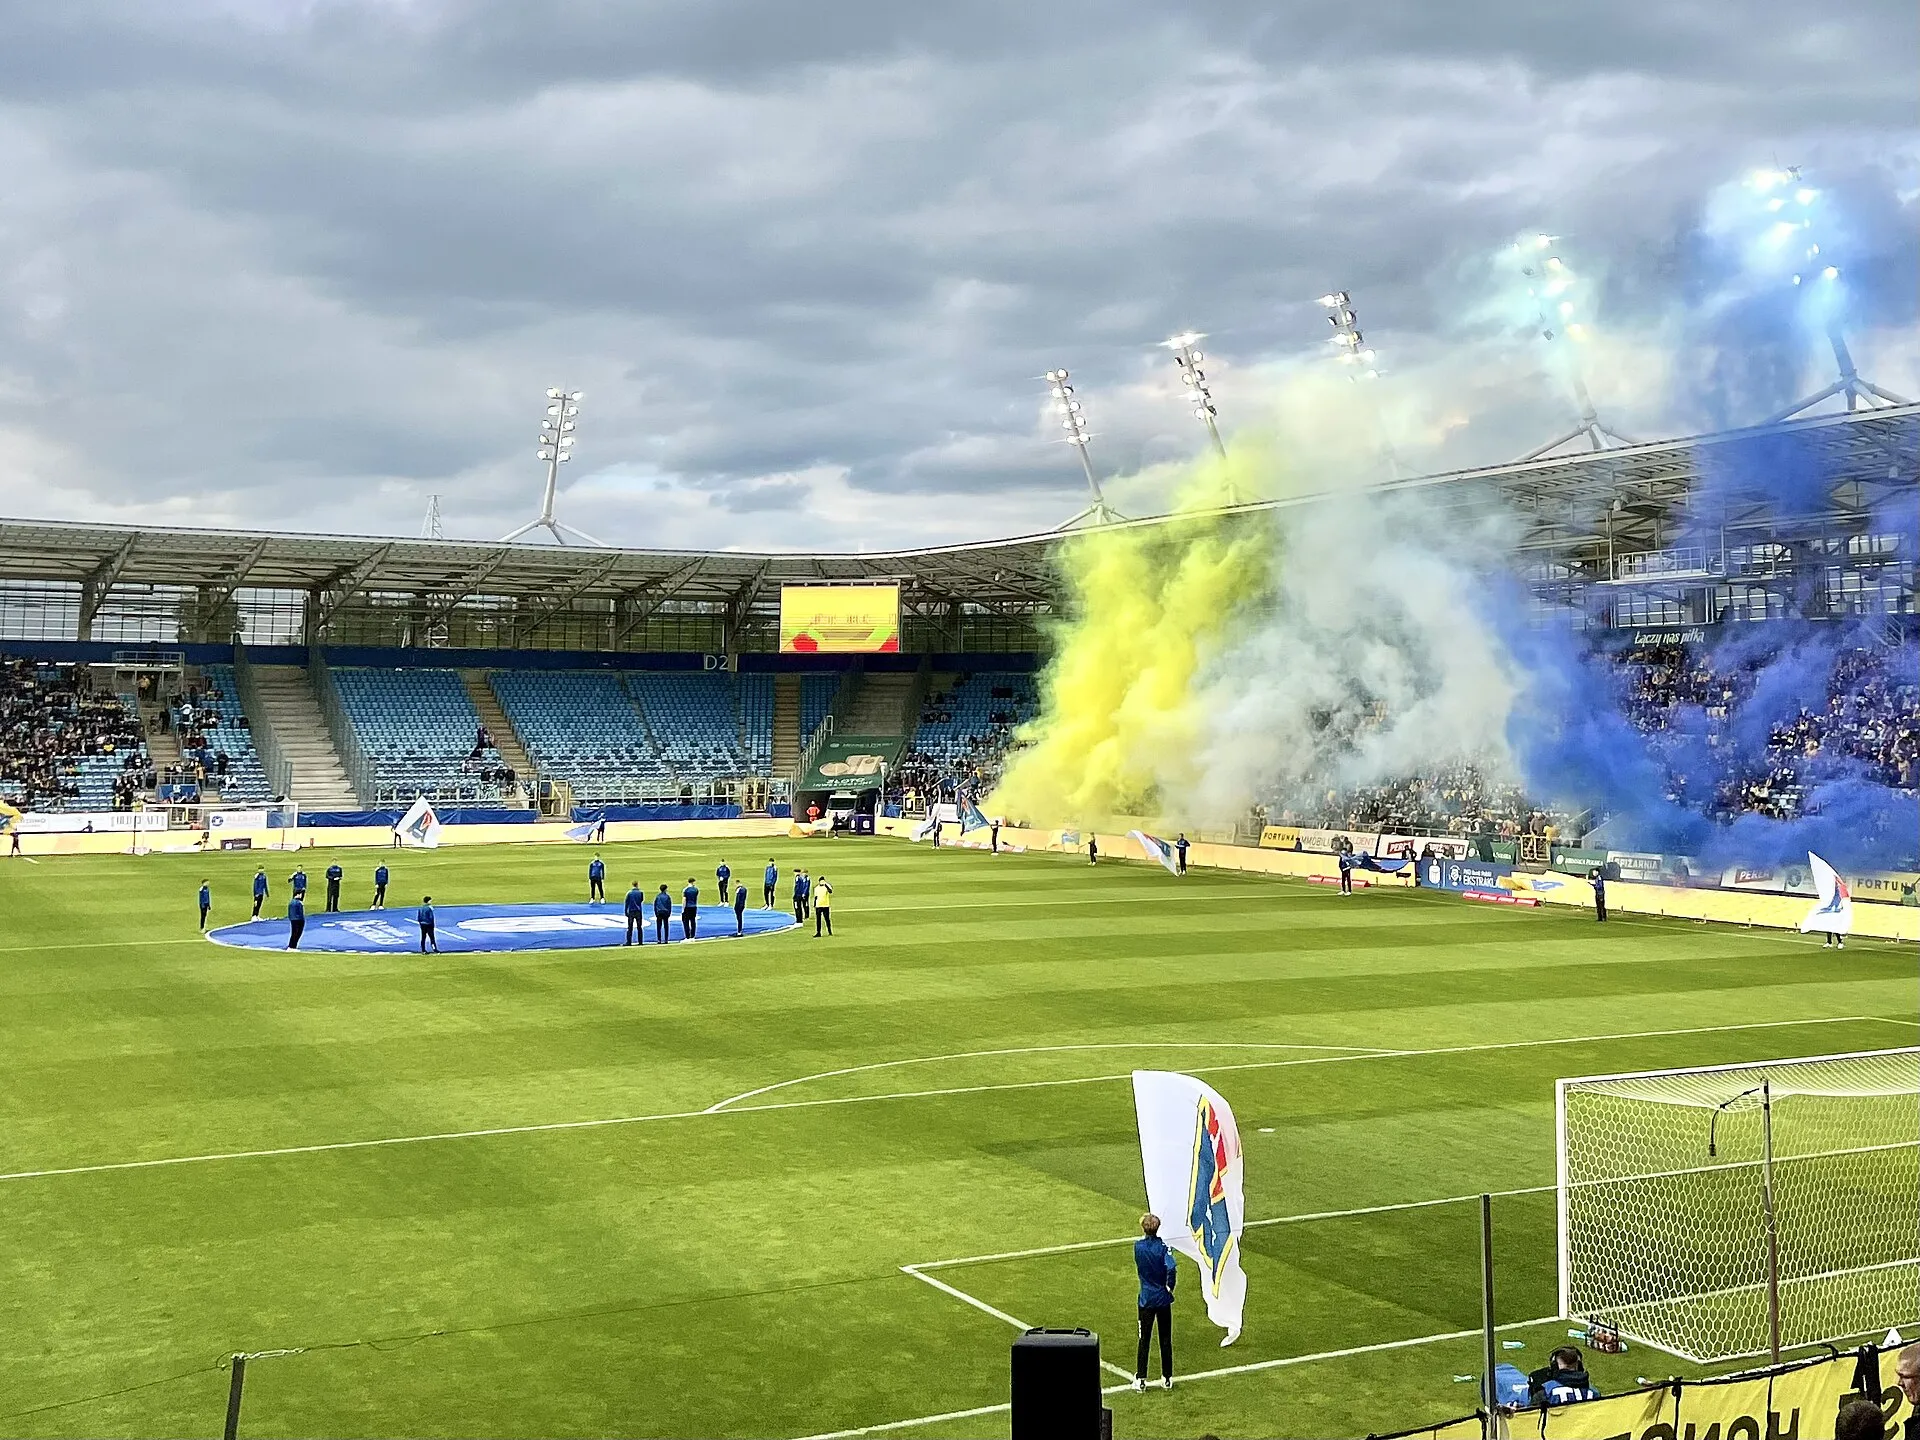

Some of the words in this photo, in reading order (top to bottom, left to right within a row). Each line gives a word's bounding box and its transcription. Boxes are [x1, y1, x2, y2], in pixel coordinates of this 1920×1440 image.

[1634, 631, 1661, 648] Łączy
[1662, 633, 1680, 644] nas
[1680, 628, 1705, 645] piłka
[704, 655, 728, 670] D2
[1263, 832, 1295, 842] FORTUNA
